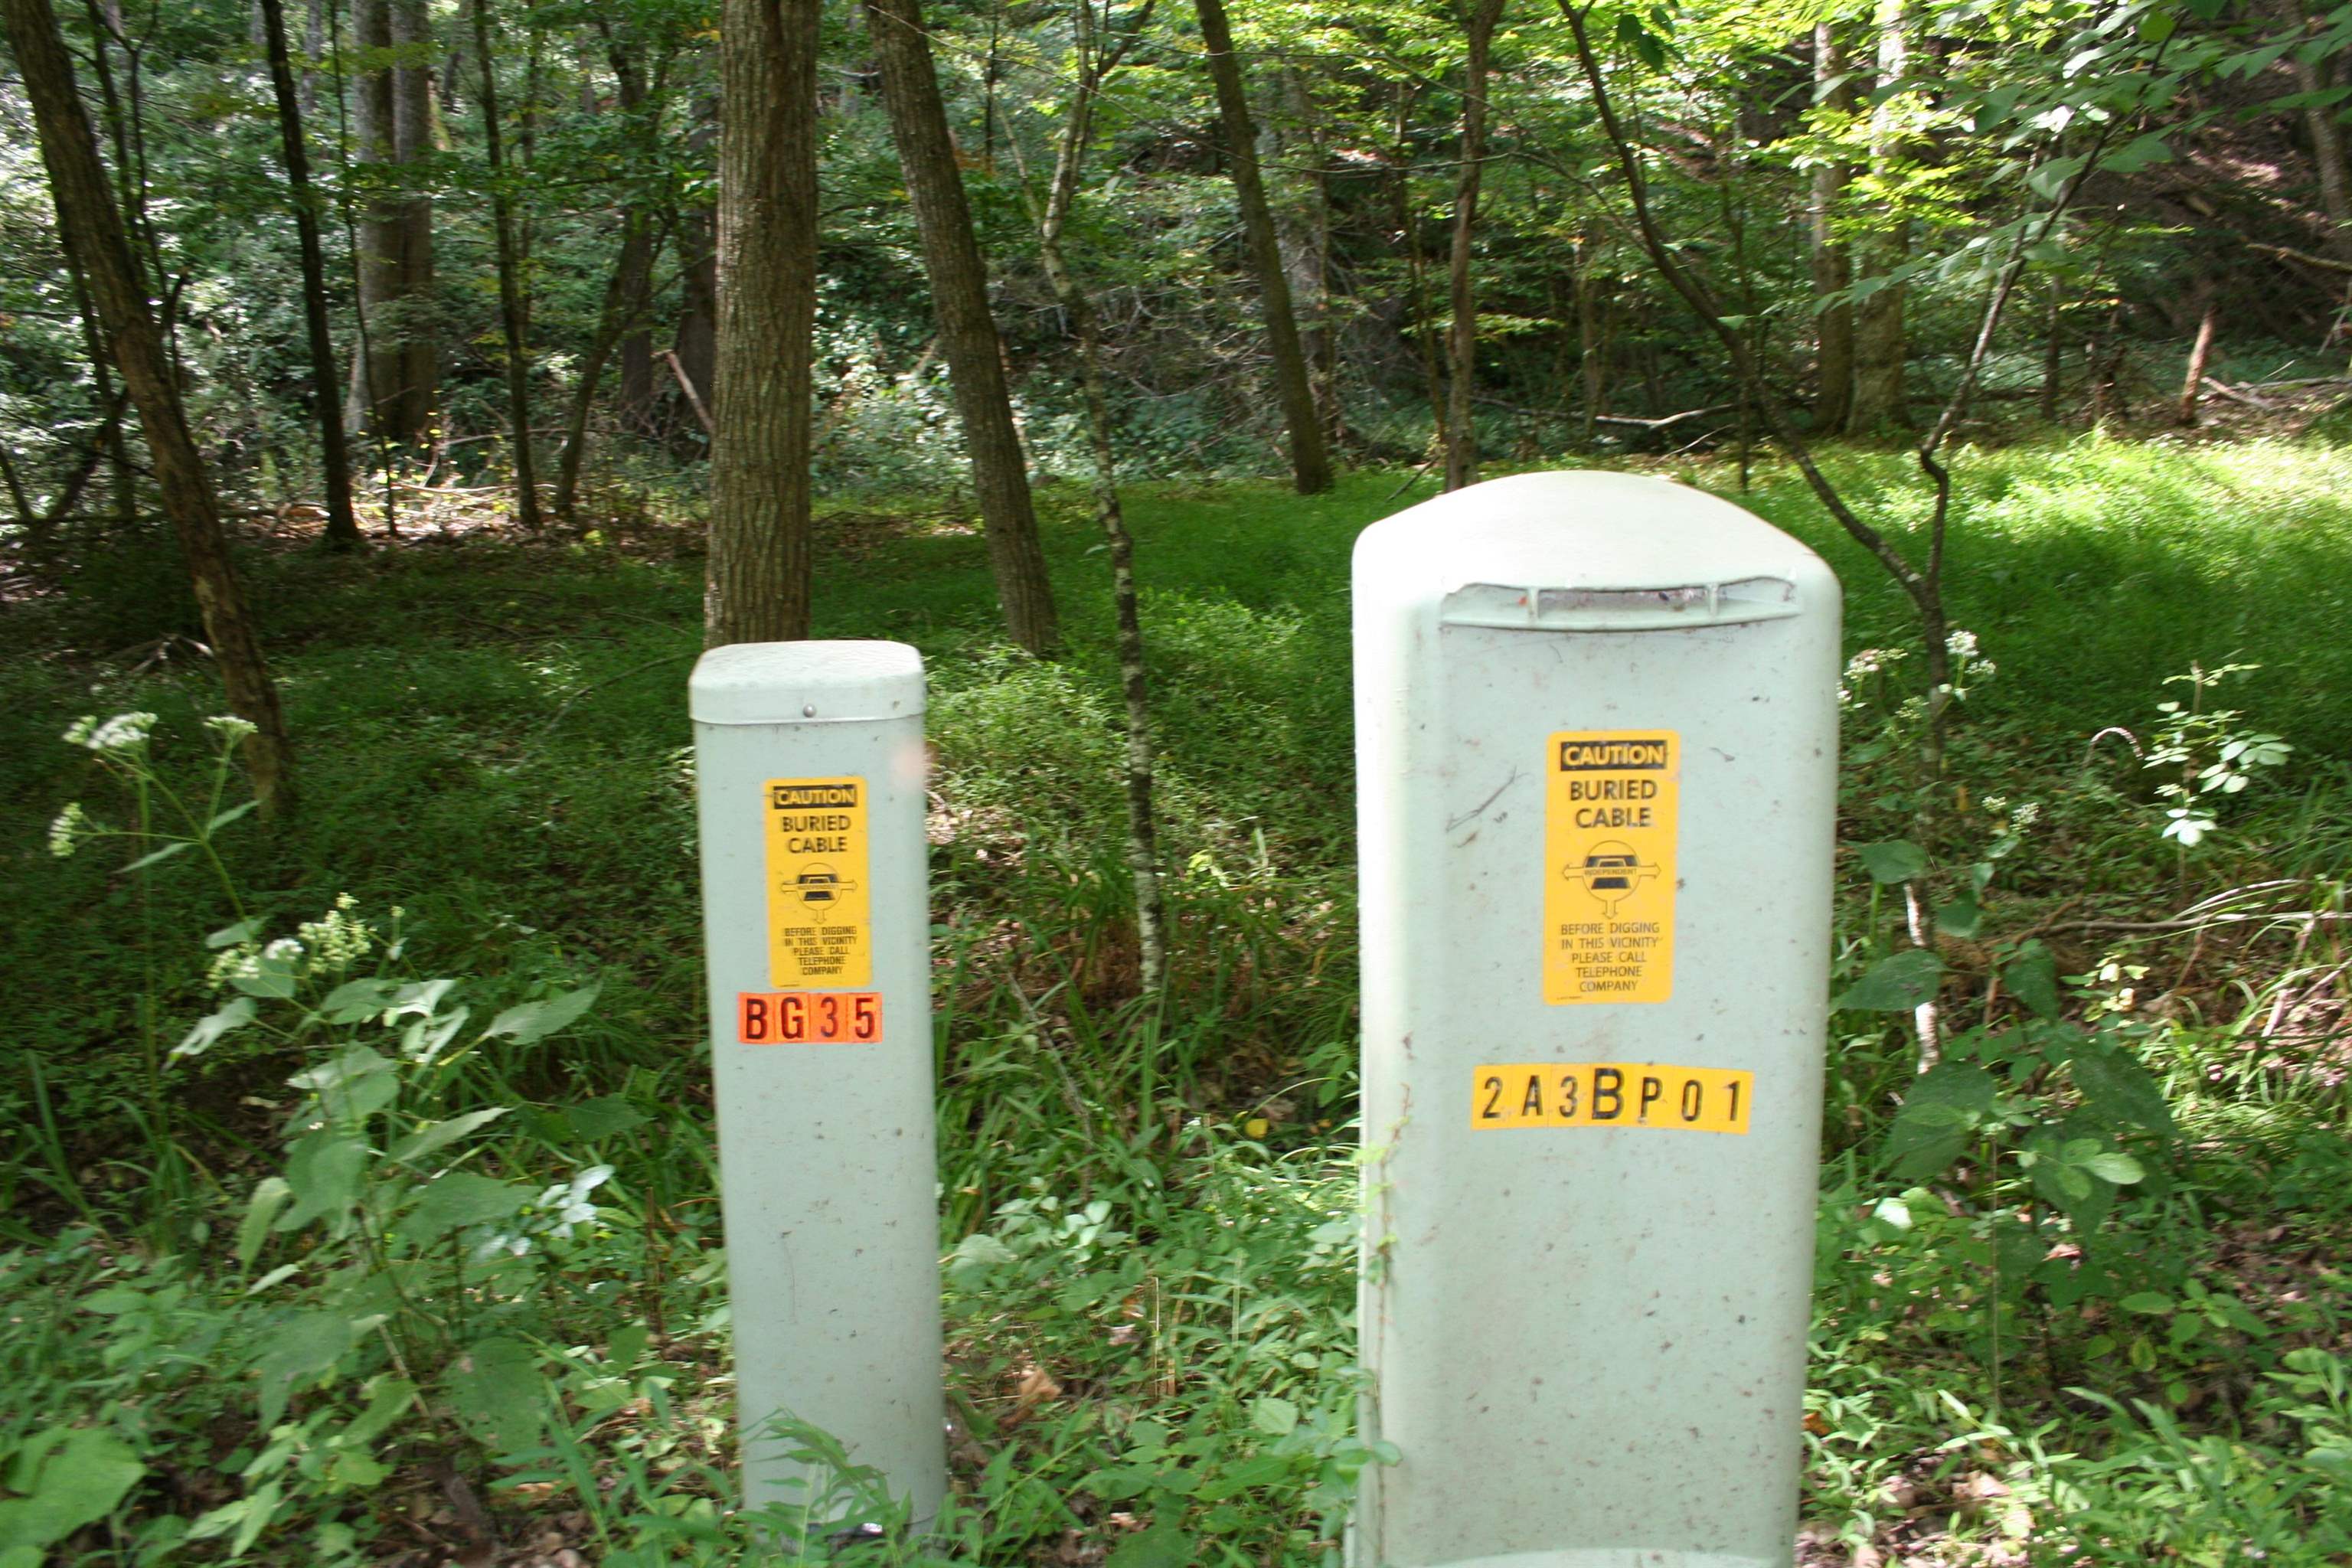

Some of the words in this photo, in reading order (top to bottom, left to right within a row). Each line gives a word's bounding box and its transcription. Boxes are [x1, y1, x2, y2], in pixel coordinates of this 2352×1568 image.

[1565, 745, 1664, 766] CAUTION
[1570, 779, 1658, 801] BURIED
[777, 789, 855, 805] CAUTION
[782, 815, 851, 832] BURIED
[1576, 808, 1651, 828] CABLE
[789, 837, 848, 854] CABLE
[784, 926, 816, 936] BEFORE
[822, 926, 857, 935] DIGGING
[1561, 923, 1604, 935] BEFORE
[1609, 922, 1660, 933] DIGGING
[785, 938, 793, 946] IN
[799, 937, 817, 946] THIS
[822, 936, 858, 946] VICINITY
[1561, 939, 1573, 949] IN
[1579, 938, 1604, 949] THIS
[1610, 937, 1658, 948] VICINITY
[793, 947, 823, 956] PLEASE
[829, 946, 849, 955] CALL
[799, 956, 845, 965] TELEPHONE
[1572, 952, 1613, 964] PLEASE
[1619, 952, 1646, 962] CALL
[802, 966, 842, 975] COMPANY
[1576, 966, 1642, 978] TELEPHONE
[1579, 981, 1638, 992] COMPANY
[746, 997, 874, 1040] BG35
[1482, 1067, 1740, 1122] 2A3BP01
